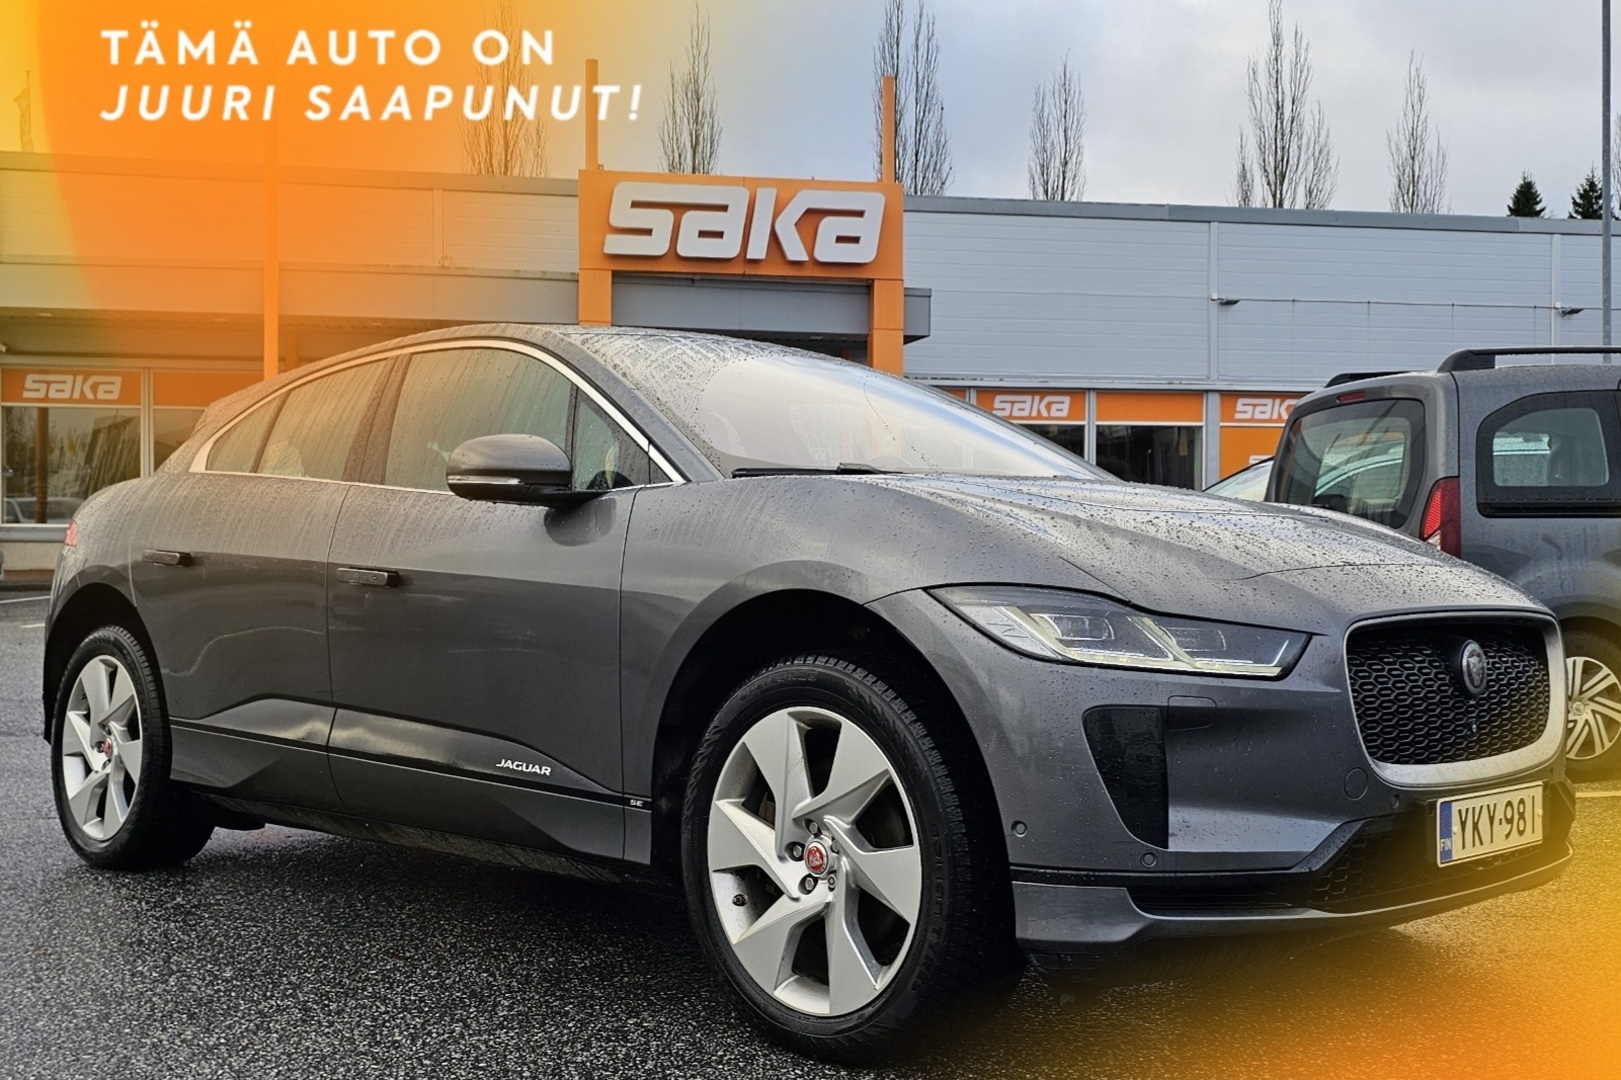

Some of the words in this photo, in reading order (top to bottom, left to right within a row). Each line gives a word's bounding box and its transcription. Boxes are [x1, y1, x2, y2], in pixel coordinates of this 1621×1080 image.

[495, 758, 552, 776] JAGUAR
[629, 798, 644, 808] SE
[1457, 794, 1536, 850] YKY-981
[1440, 837, 1452, 852] FIN
